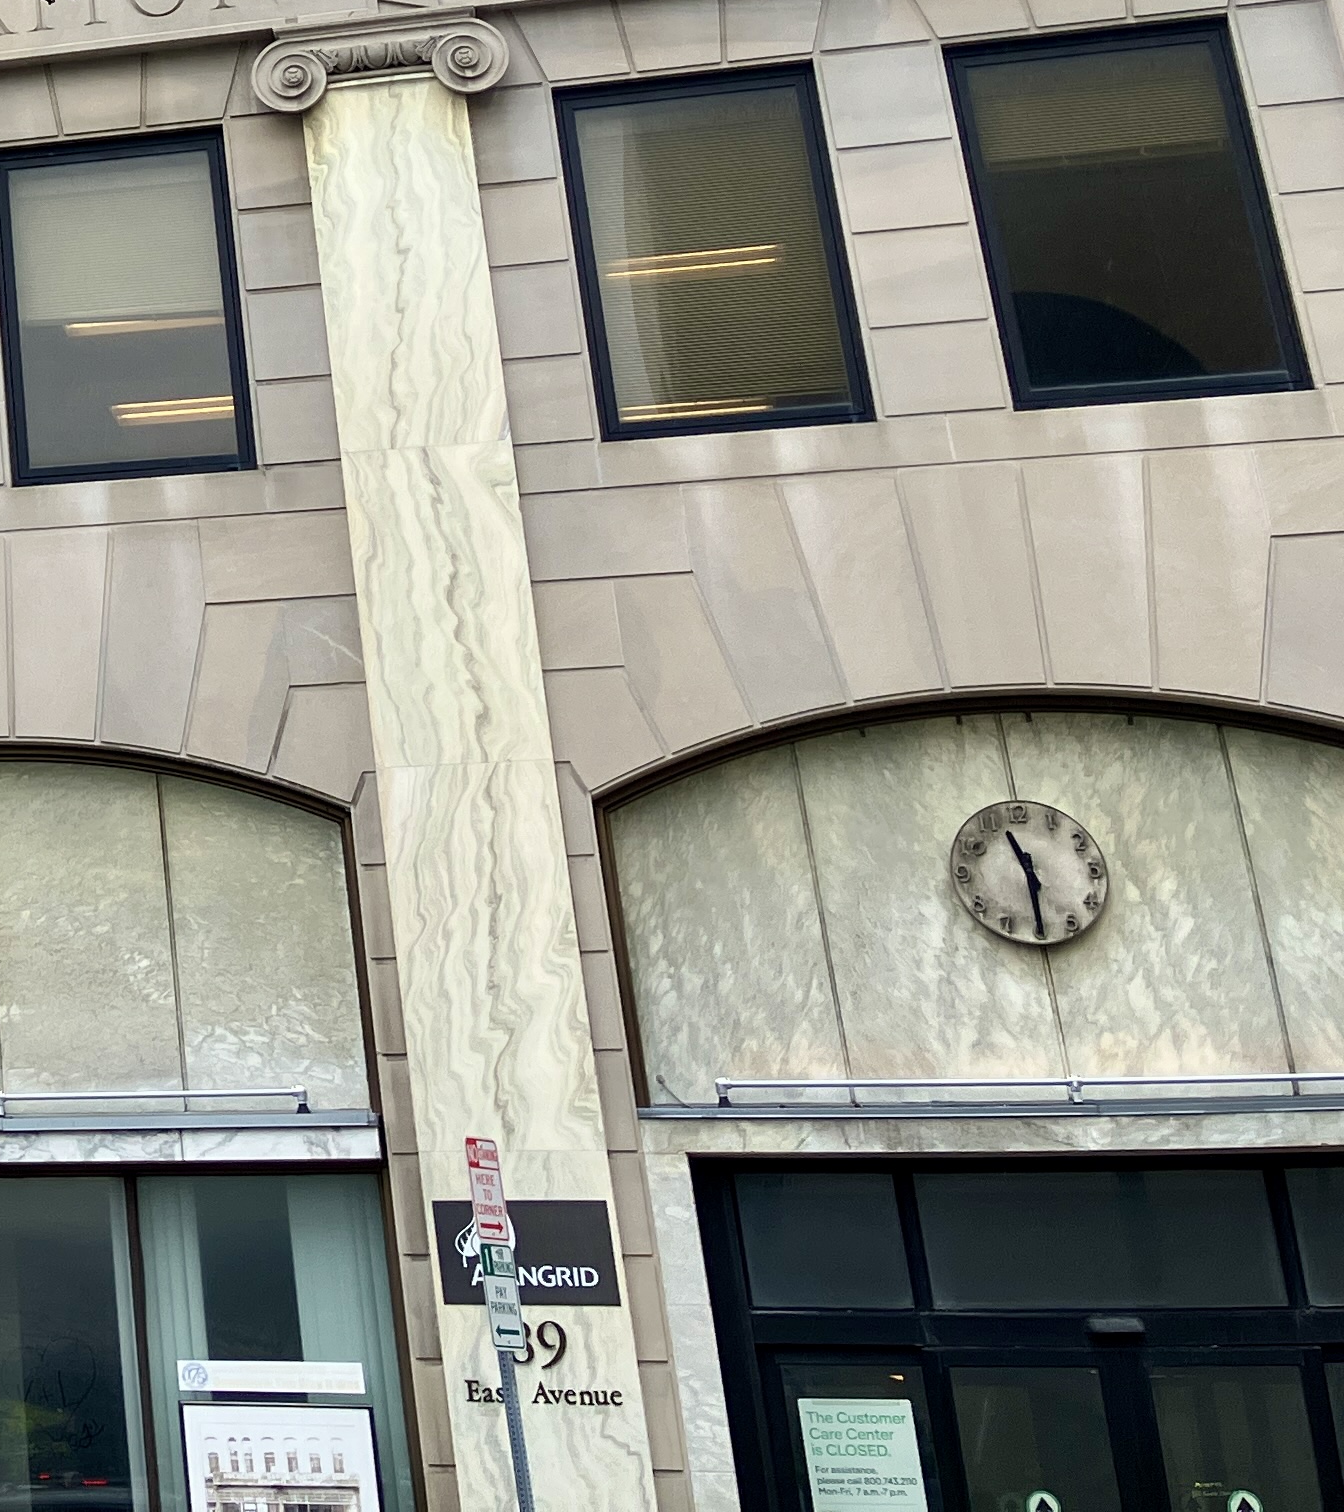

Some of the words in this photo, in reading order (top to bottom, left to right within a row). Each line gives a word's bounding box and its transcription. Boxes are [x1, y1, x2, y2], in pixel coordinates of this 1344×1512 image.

[978, 813, 999, 832] 11
[1006, 806, 1027, 823] 12
[1046, 814, 1058, 830] 1
[960, 839, 987, 856] 10
[1072, 832, 1087, 852] 2
[955, 865, 971, 883] 9
[973, 896, 986, 912] 8
[1083, 891, 1100, 910] 4
[999, 917, 1012, 932] 7
[475, 1174, 495, 1186] HERE
[483, 1189, 492, 1200] TO
[476, 1203, 503, 1216] CORNER
[471, 1263, 599, 1287] ANGRID
[465, 1380, 504, 1404] Eas
[532, 1381, 624, 1407] Avenue
[805, 1411, 833, 1423] The
[837, 1412, 906, 1424] Customer
[809, 1428, 843, 1440] Care
[846, 1428, 893, 1440] Center
[812, 1444, 823, 1456] is
[826, 1444, 891, 1457] CLOSED.
